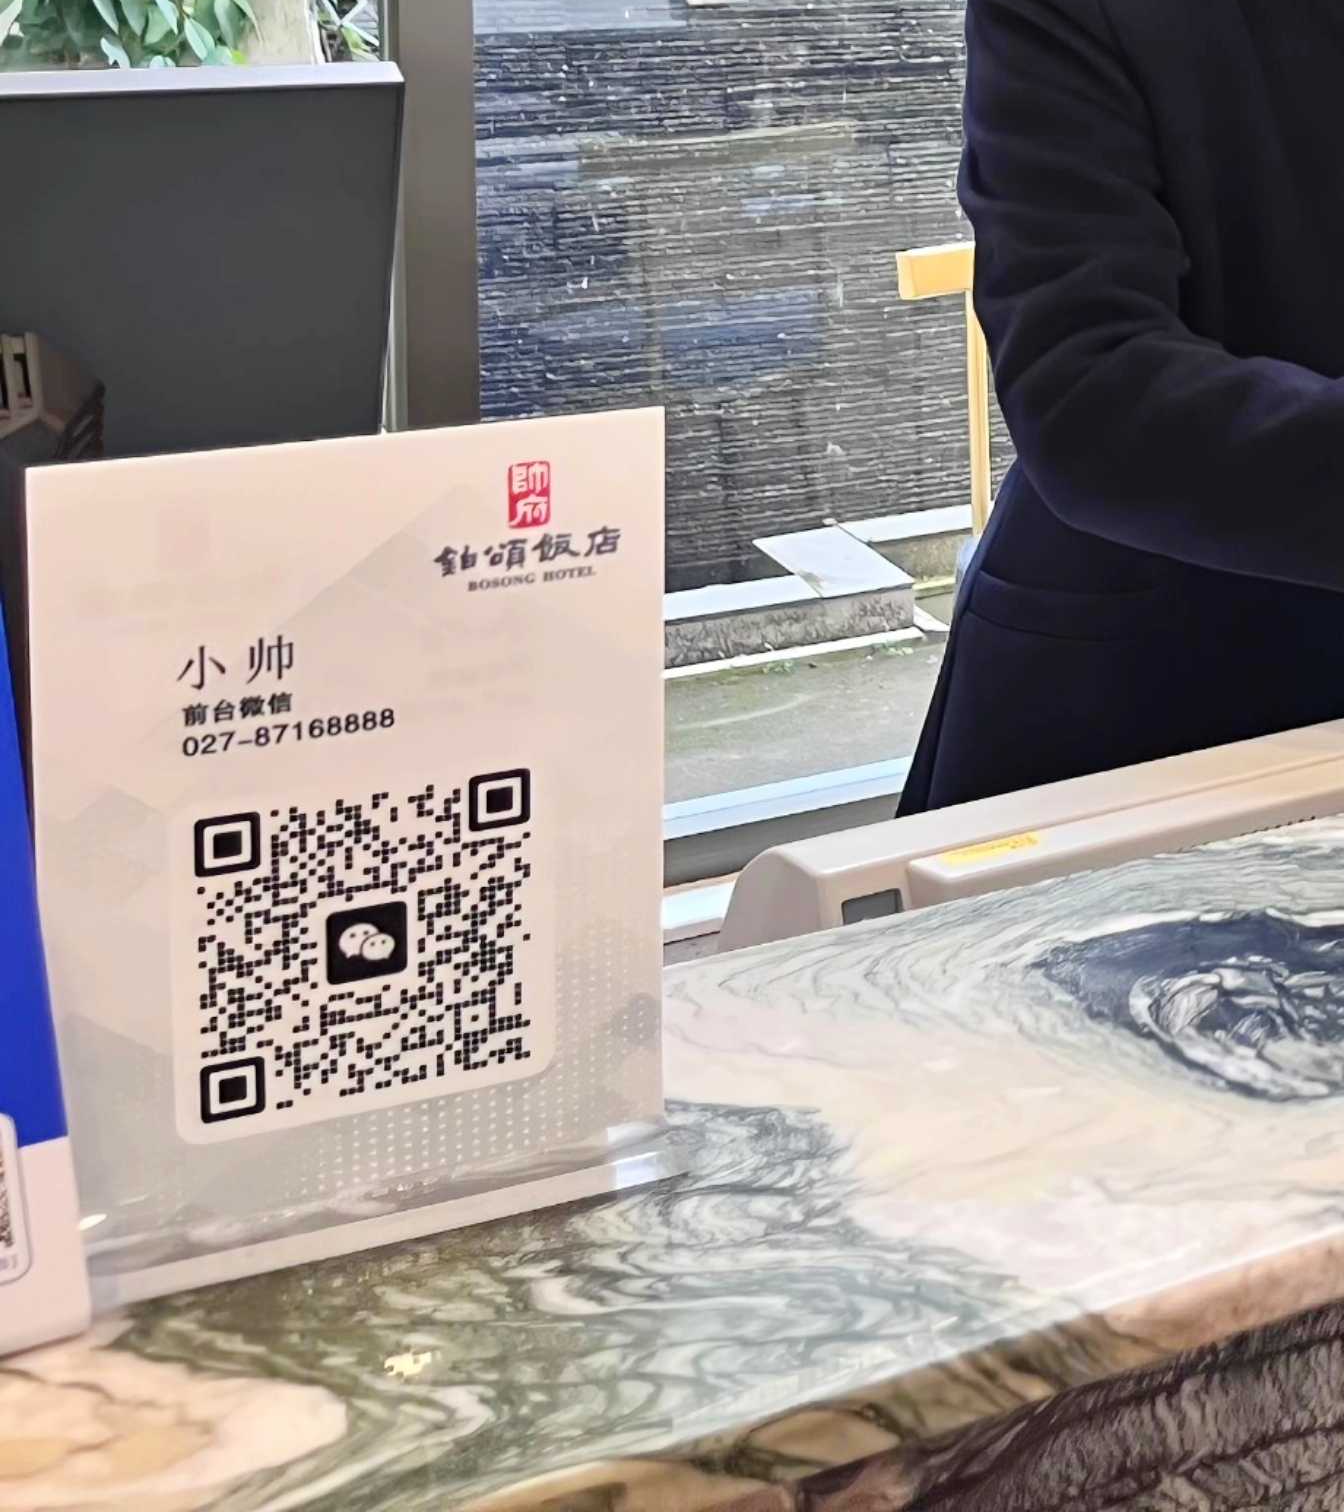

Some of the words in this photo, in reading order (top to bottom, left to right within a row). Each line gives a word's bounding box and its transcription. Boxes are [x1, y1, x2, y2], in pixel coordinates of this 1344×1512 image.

[467, 572, 536, 592] BOSONG
[543, 565, 596, 583] HOTEL
[176, 635, 294, 690] 小帅
[182, 692, 293, 727] 前台微信
[181, 708, 395, 757] 027-87168888
